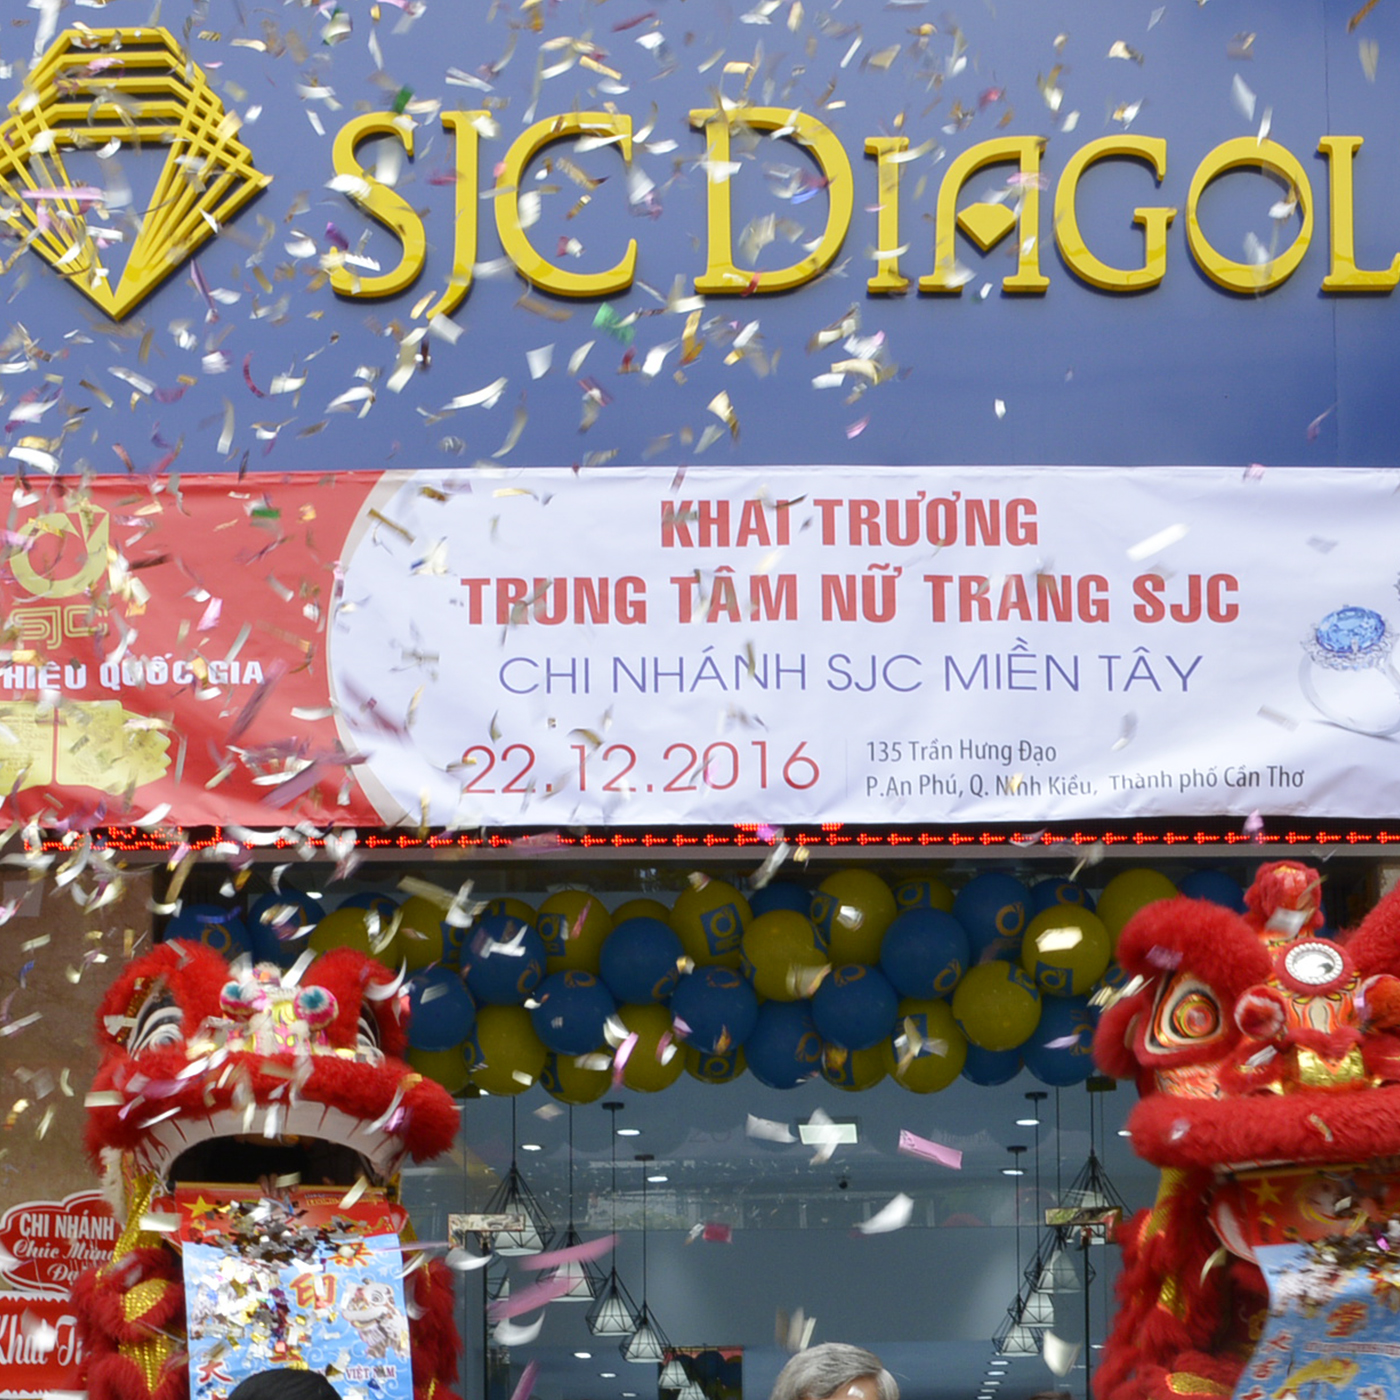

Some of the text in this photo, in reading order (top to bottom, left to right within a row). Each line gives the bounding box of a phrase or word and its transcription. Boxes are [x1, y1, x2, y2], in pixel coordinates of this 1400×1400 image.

[329, 110, 637, 320] SJC
[660, 490, 1039, 548] KHAI TRƯƠNG
[461, 562, 1240, 626] TRUNG TÂM NỮ TRANG SJC
[10, 604, 109, 649] SJC
[211, 659, 265, 686] GIA
[499, 637, 1204, 695] CHI NHÁNH SJC MIỀN TÂY
[461, 740, 821, 795] 22.12.2016
[866, 739, 1058, 768] 135 Trần Hưng Đạo
[919, 773, 966, 800] Phú,
[970, 775, 990, 799] Q.
[1048, 773, 1099, 799] Kiều,
[1109, 771, 1173, 793] Thành
[1179, 765, 1218, 793] phố
[1224, 765, 1260, 788] Cần
[1266, 764, 1305, 788] Thơ
[19, 1209, 116, 1241] CHI NHÁNH
